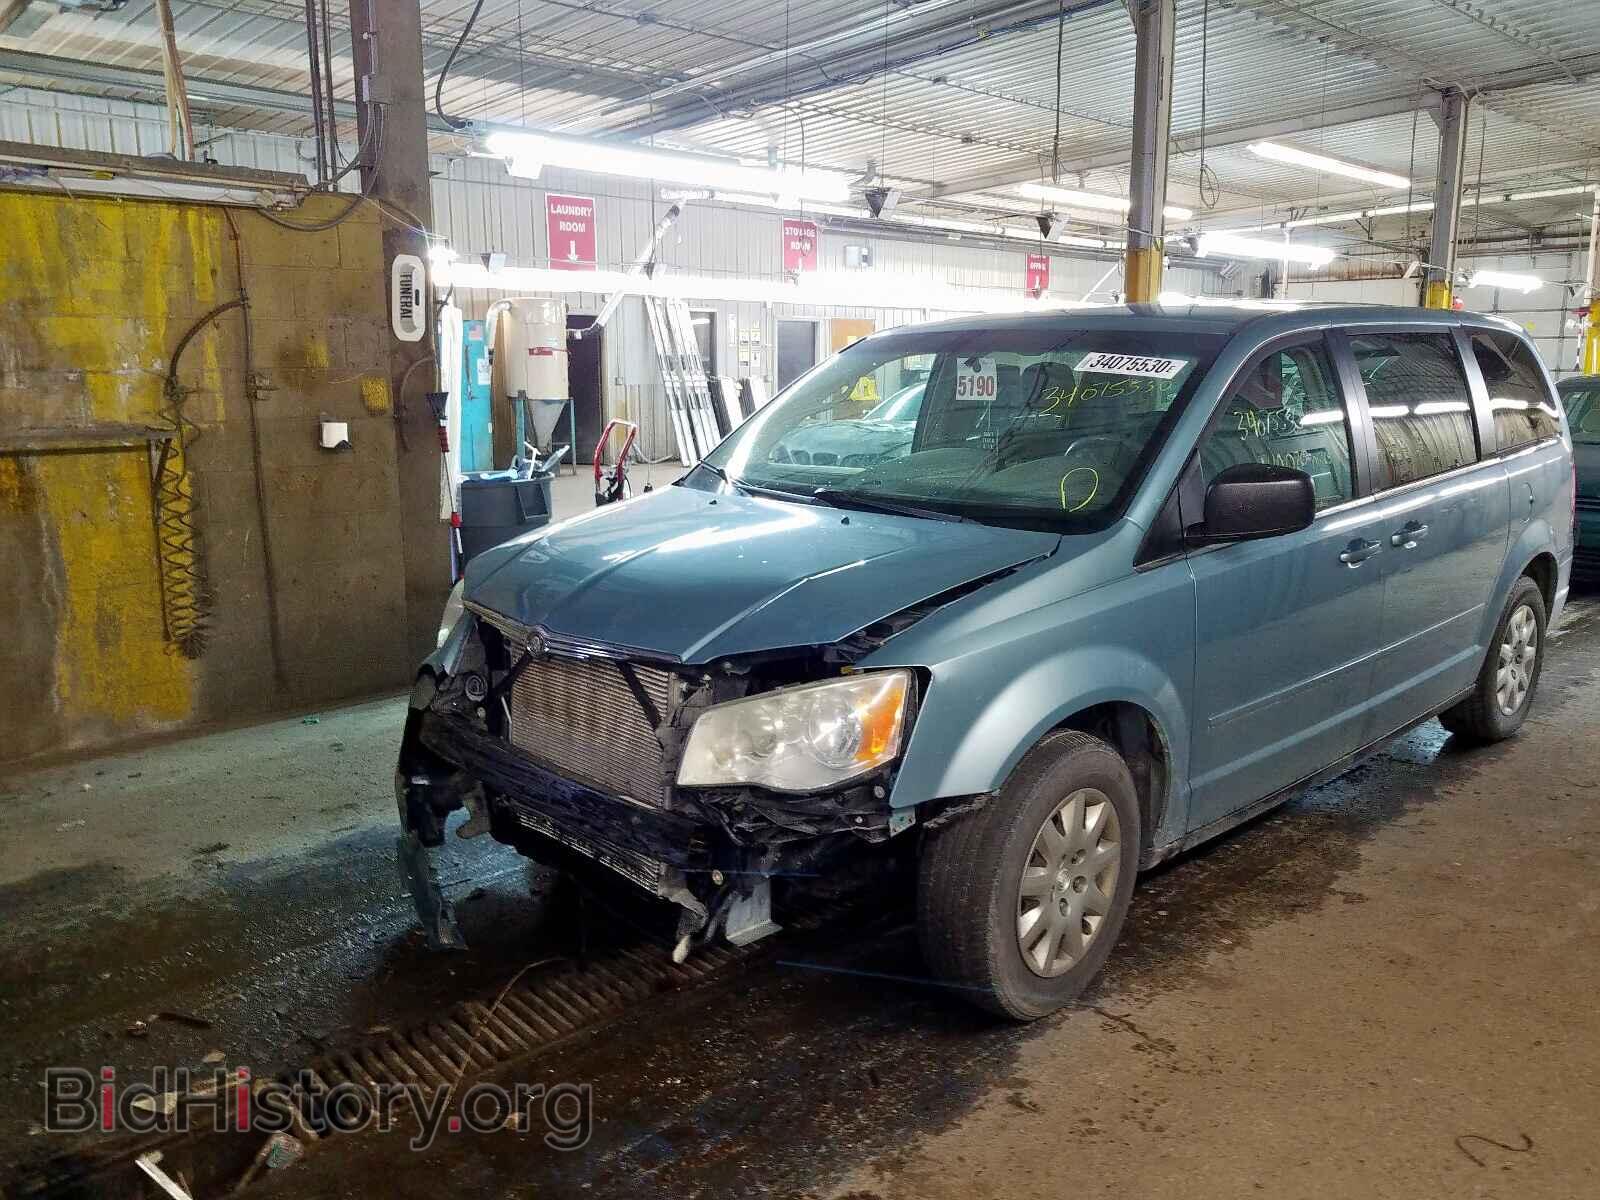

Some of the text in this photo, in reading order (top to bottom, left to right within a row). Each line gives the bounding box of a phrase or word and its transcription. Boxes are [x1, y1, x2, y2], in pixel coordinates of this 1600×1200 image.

[550, 204, 592, 217] LAUNDRY
[559, 221, 586, 233] ROOM
[400, 272, 413, 321] FUNERAL
[958, 375, 995, 397] 5190
